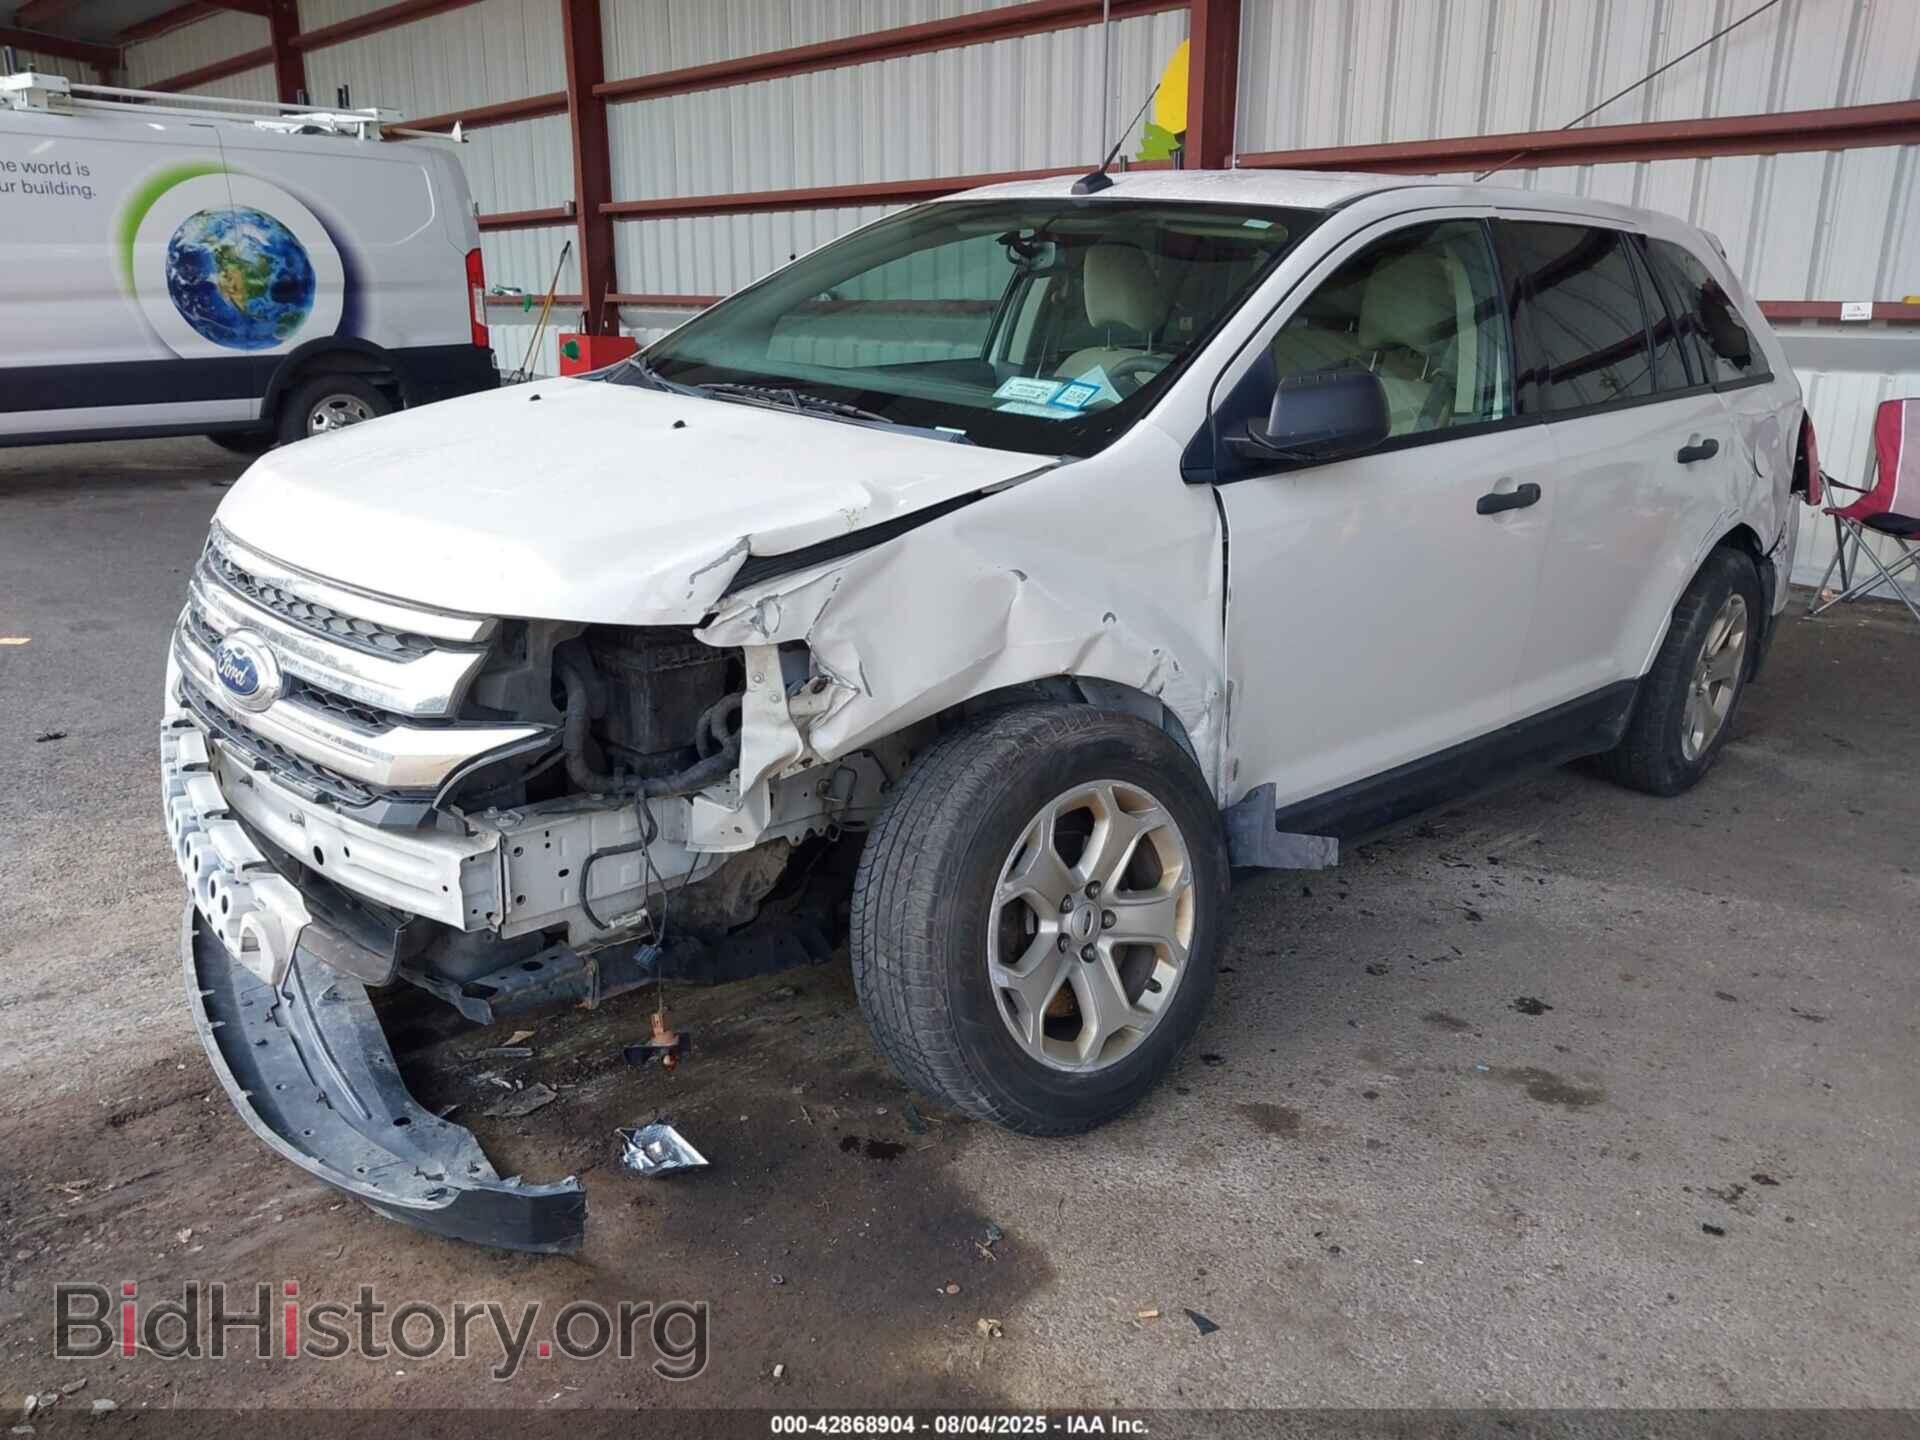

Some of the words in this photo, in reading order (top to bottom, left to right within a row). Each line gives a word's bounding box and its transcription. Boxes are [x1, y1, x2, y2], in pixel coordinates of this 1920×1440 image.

[21, 161, 72, 175] world
[75, 161, 91, 176] is
[21, 179, 96, 199] building.
[218, 648, 249, 687] Ford
